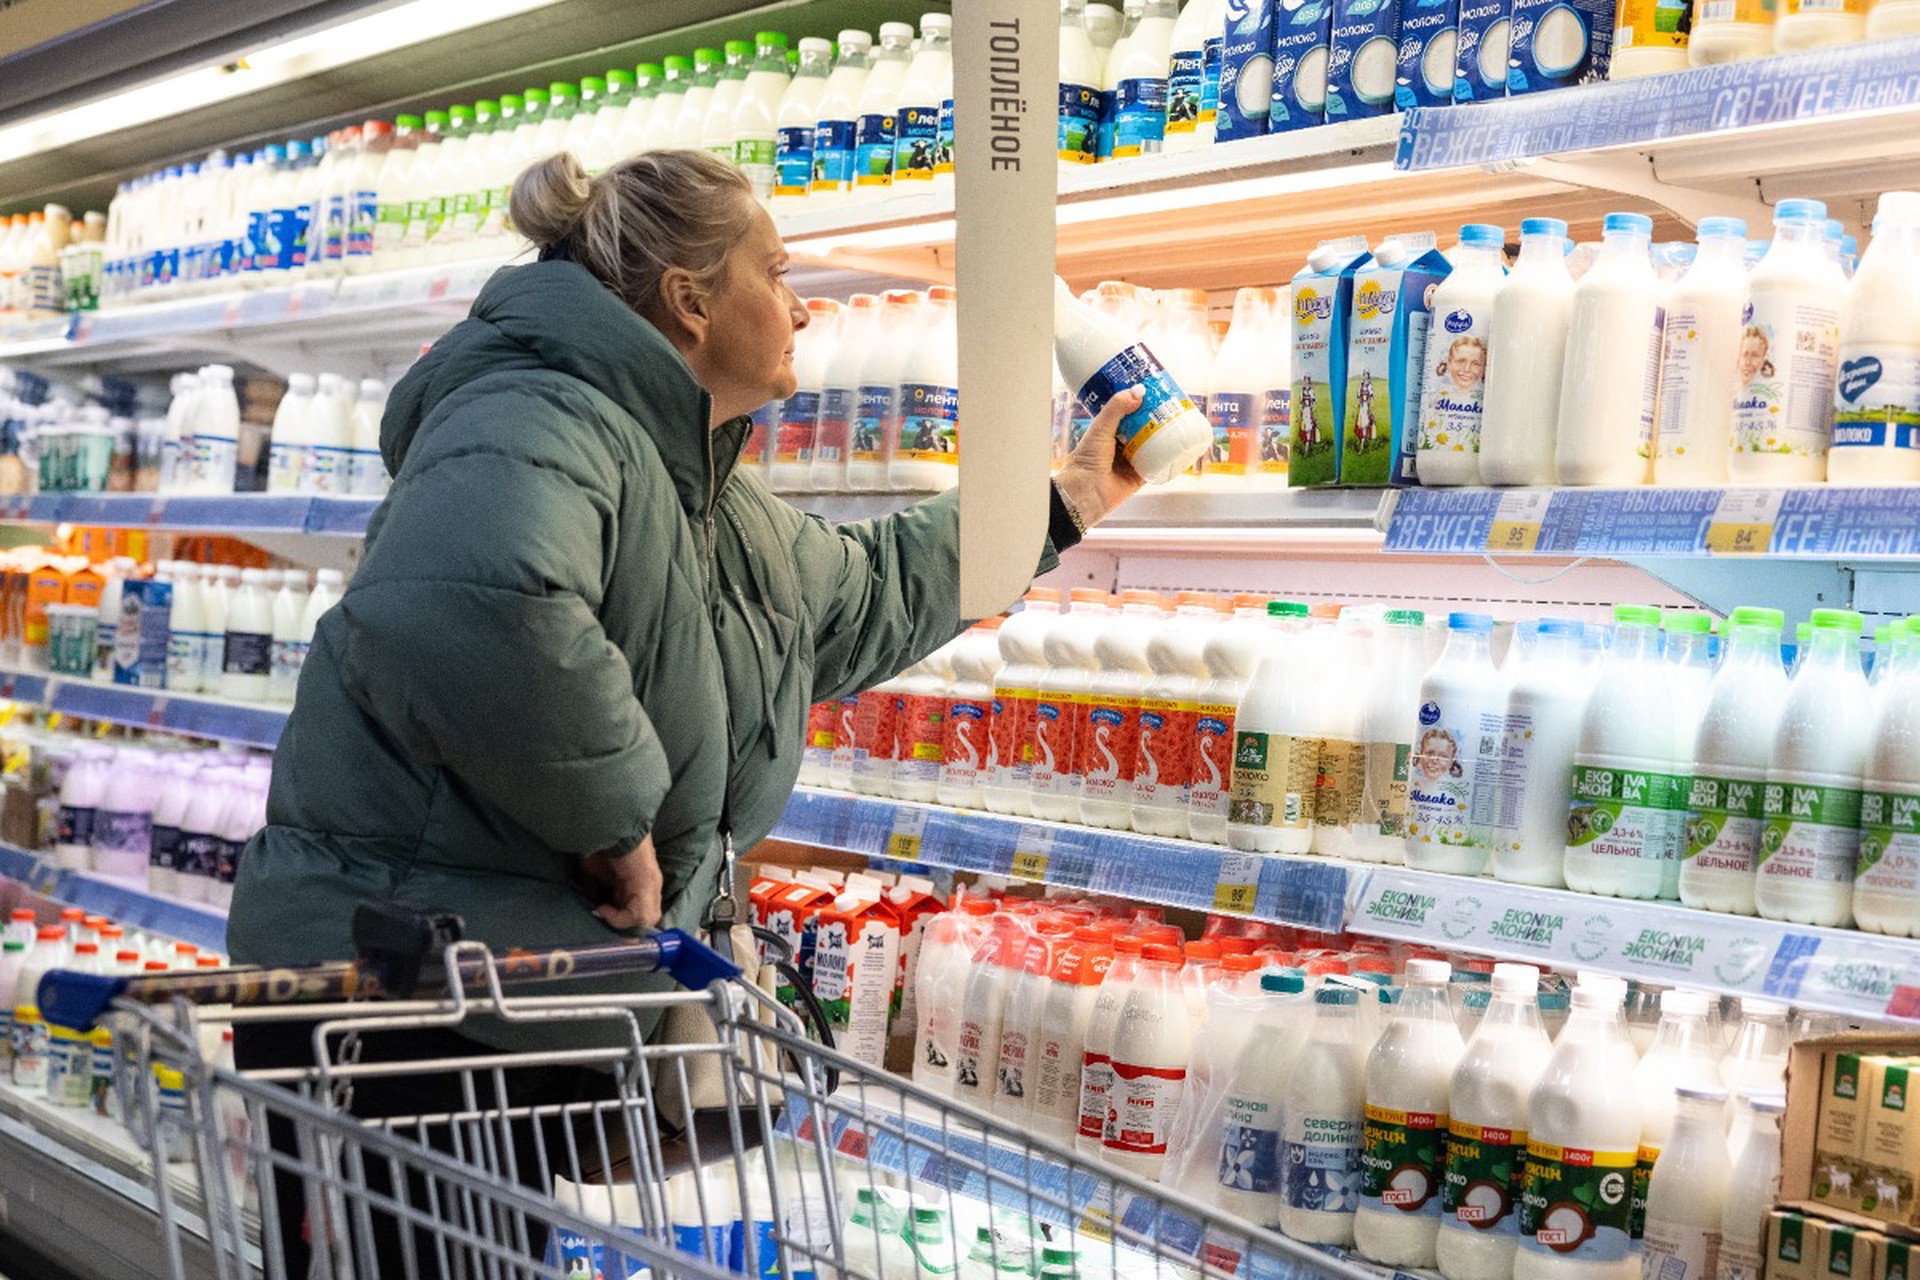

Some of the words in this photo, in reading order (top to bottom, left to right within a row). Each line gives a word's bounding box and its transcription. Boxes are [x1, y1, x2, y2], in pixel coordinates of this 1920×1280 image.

[1332, 23, 1375, 39] МОЛОКО
[1402, 13, 1446, 30] МОЛОКО
[1637, 66, 1719, 101] ВЫСОКОЕ
[990, 17, 1027, 172] ТОПЛЁНОЕ
[1710, 72, 1841, 129] СВЕЖЕЕ
[1394, 124, 1502, 171] СВЕЖЕЕ
[1266, 399, 1290, 412] лен
[1437, 491, 1489, 512] ВСЕГДА
[1621, 490, 1706, 513] ВЫСОКОЕ
[1384, 514, 1485, 551] СВЕЖЕЕ
[1509, 527, 1523, 542] 95
[1829, 527, 1914, 554] ДЕНЬГИ
[1409, 789, 1457, 806] Молоко
[1591, 842, 1642, 858] ЦЕЛЬНОЕ
[1696, 856, 1749, 872] ЦЕЛЬНОЕ
[1764, 863, 1814, 879] ЦЕЛЬНОЕ
[1380, 889, 1437, 910] EKONIVA
[1366, 901, 1425, 924] ЭКОНИВА
[1504, 908, 1564, 931] EKONIVA
[1488, 920, 1553, 944] ЭКОНИВА
[1637, 928, 1704, 953] EKONIVA
[1622, 941, 1694, 967] ЭКОНИВА
[1304, 1117, 1362, 1132] северн
[1303, 1131, 1357, 1144] долин
[1385, 1192, 1408, 1201] ГОСТ
[1459, 1208, 1482, 1218] ГОСТ
[1538, 1232, 1562, 1242] ГОСТ
